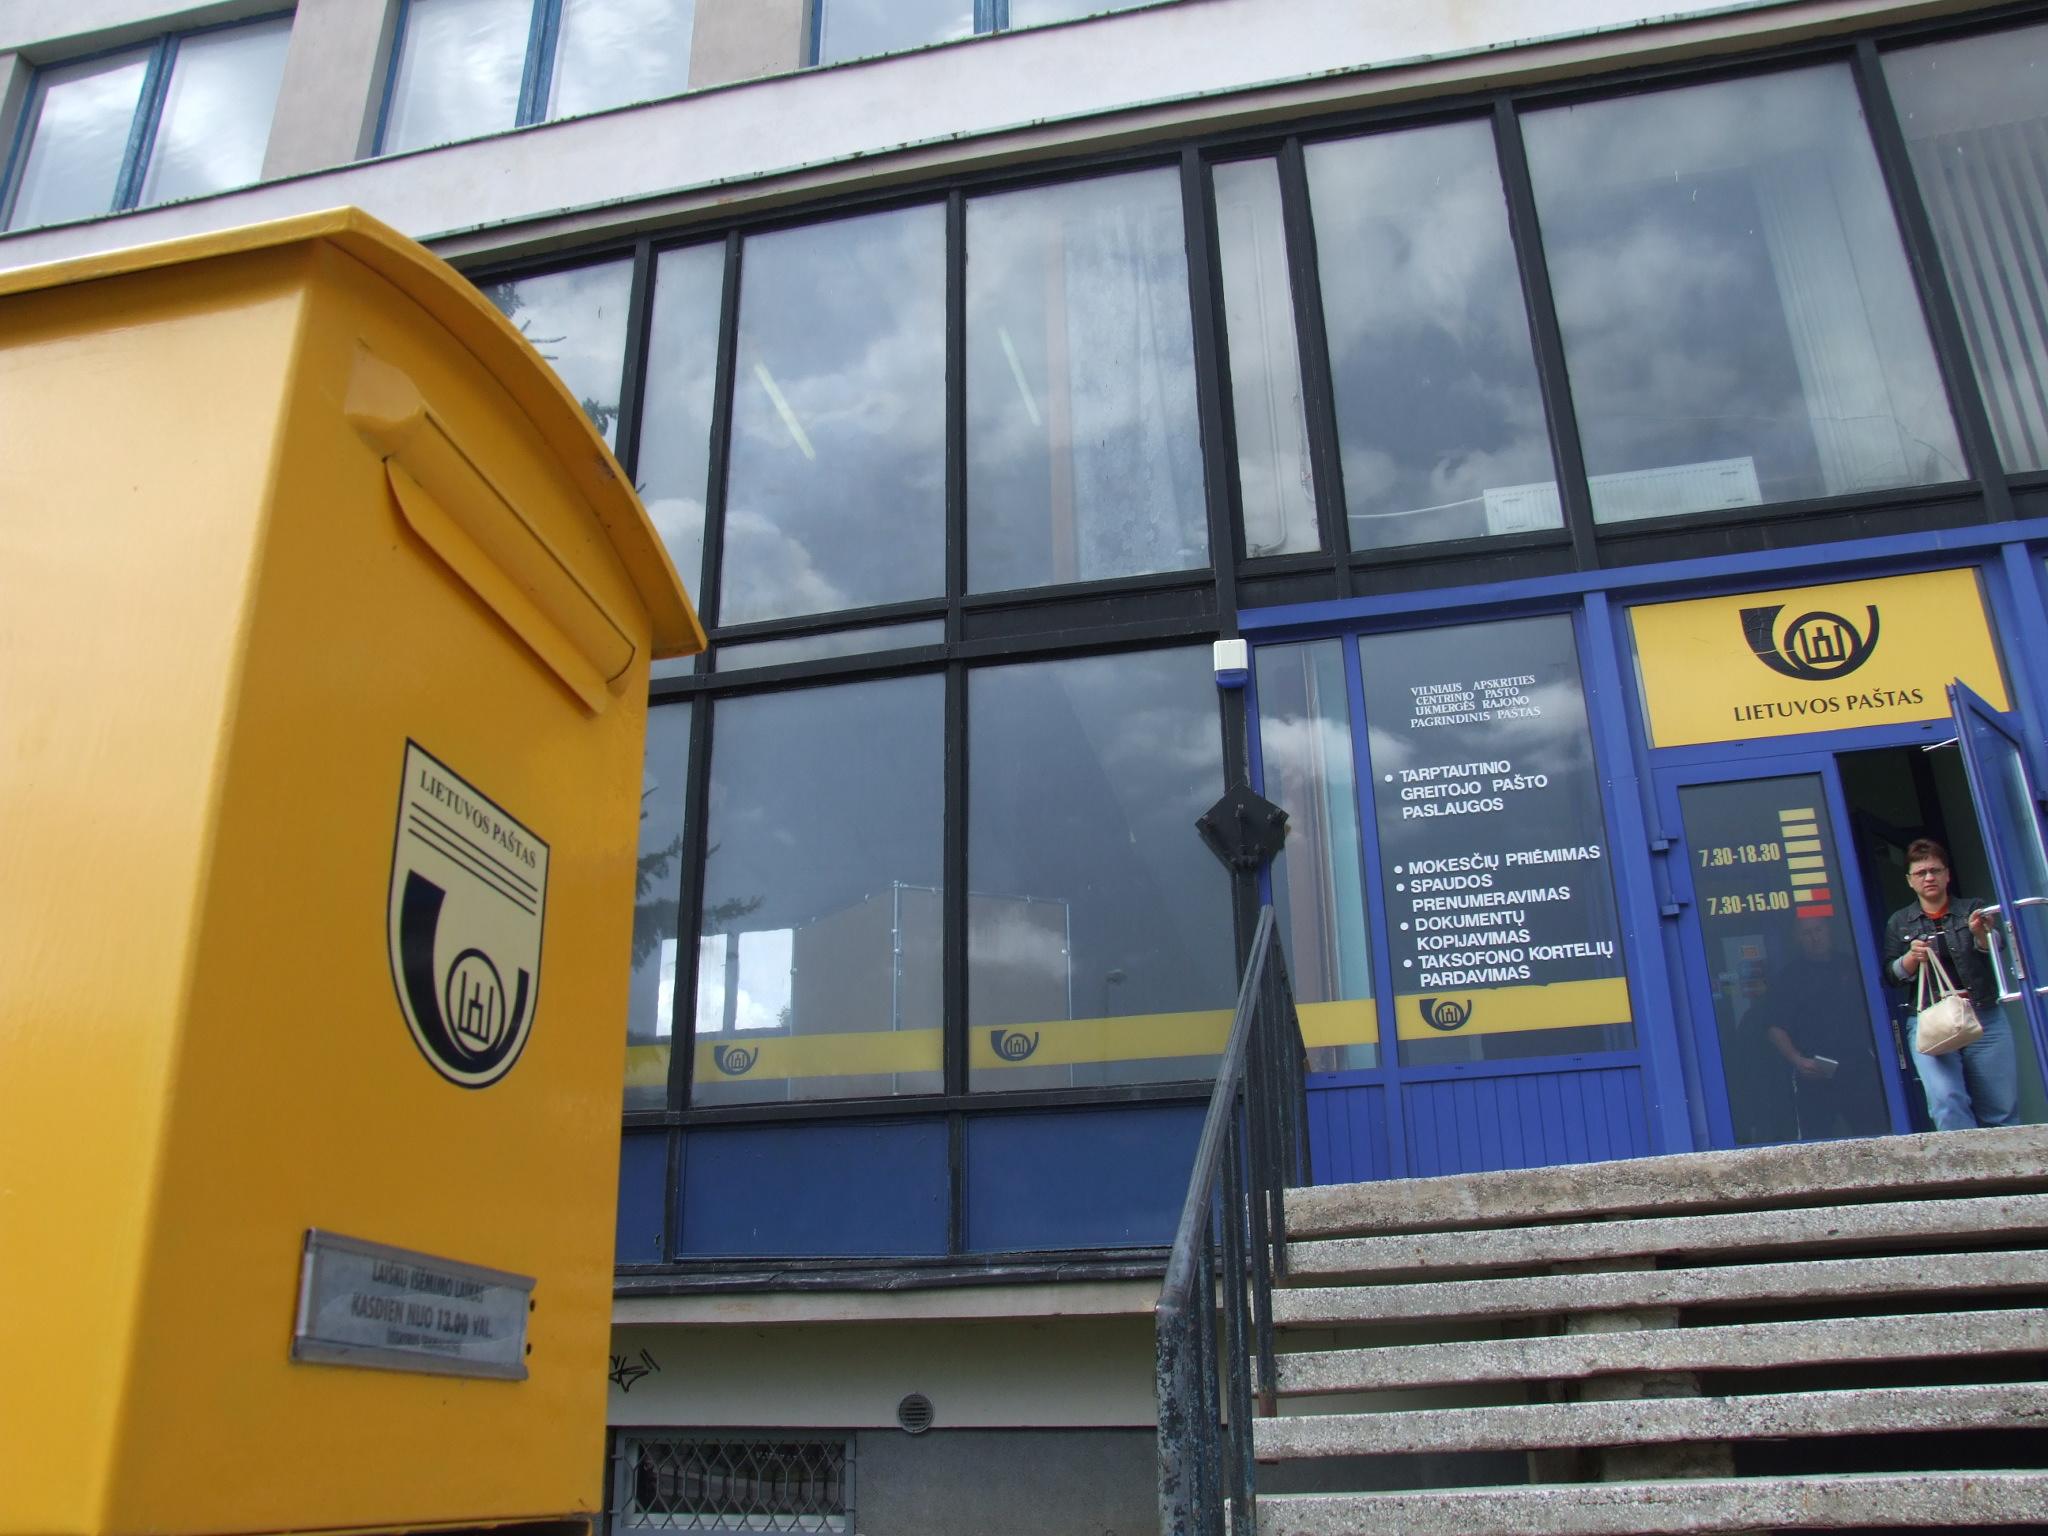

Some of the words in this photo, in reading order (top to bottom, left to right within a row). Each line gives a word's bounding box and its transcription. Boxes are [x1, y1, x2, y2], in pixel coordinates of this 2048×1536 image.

[1410, 682, 1462, 697] VILNIAUS
[1473, 675, 1536, 690] APSKRITIES
[1416, 691, 1474, 706] CENTRINIO
[1482, 695, 1529, 709] RAJONO
[1734, 696, 1840, 722] LIETUVOS
[1847, 688, 1923, 711] PAŠTAS
[1410, 711, 1491, 728] PAGRINDINIS
[1399, 760, 1511, 783] TARPTAUTINIO
[1401, 781, 1482, 800] GREITOJO
[1492, 774, 1548, 792] PAŠTO
[420, 769, 490, 834] LIETUVOS
[492, 822, 536, 869] PAŠTAS
[1402, 798, 1504, 819] PASLAUGOS
[1408, 853, 1499, 875] MOKESČIŲ
[1505, 845, 1600, 867] PRIĖMIMAS
[1698, 842, 1780, 868] 7.30-18.30
[1410, 874, 1493, 893] SPAUDOS
[1412, 886, 1571, 913] PRENUMERAVIMAS
[1707, 891, 1790, 916] 7.30-15.00
[1415, 910, 1525, 932] DOKUMENTŲ
[1416, 929, 1531, 951] KOPIJAVIMAS
[1418, 947, 1524, 969] TAKSOFONO
[1528, 941, 1613, 961] KORTELIŲ
[1420, 965, 1531, 987] PARDAVIMAS
[352, 1292, 403, 1323] KASDIEN
[406, 1304, 433, 1328] NUO
